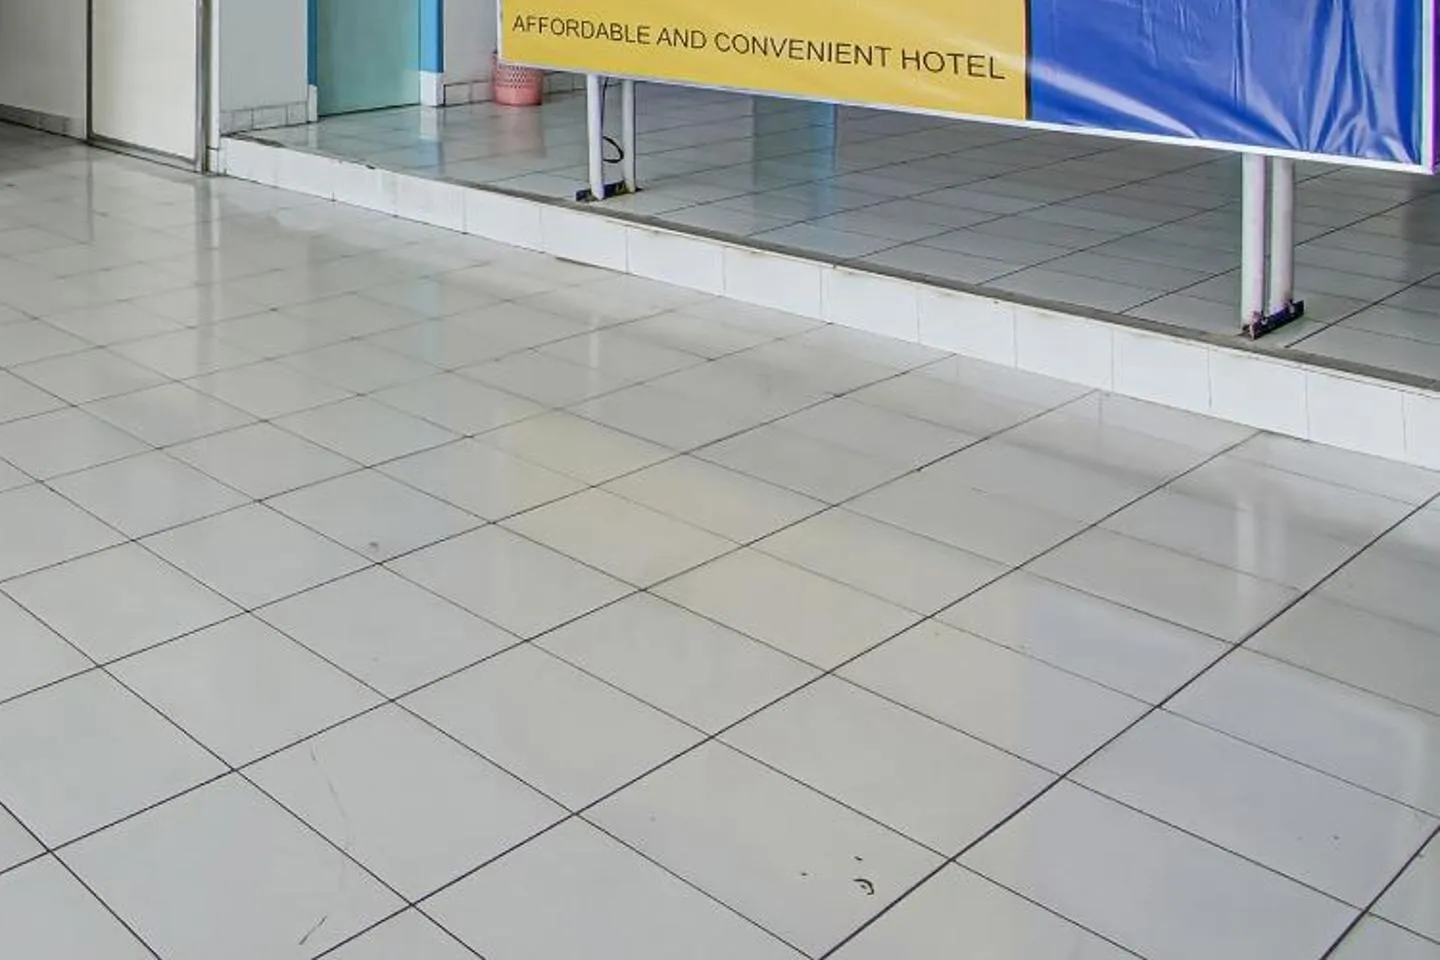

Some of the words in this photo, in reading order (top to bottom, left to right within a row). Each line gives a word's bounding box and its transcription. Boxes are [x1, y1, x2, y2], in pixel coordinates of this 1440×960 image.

[511, 14, 651, 46] AFFORDABLE
[656, 28, 708, 51] AND
[713, 33, 891, 68] CONVENIENT
[899, 50, 1006, 81] HOTEL
